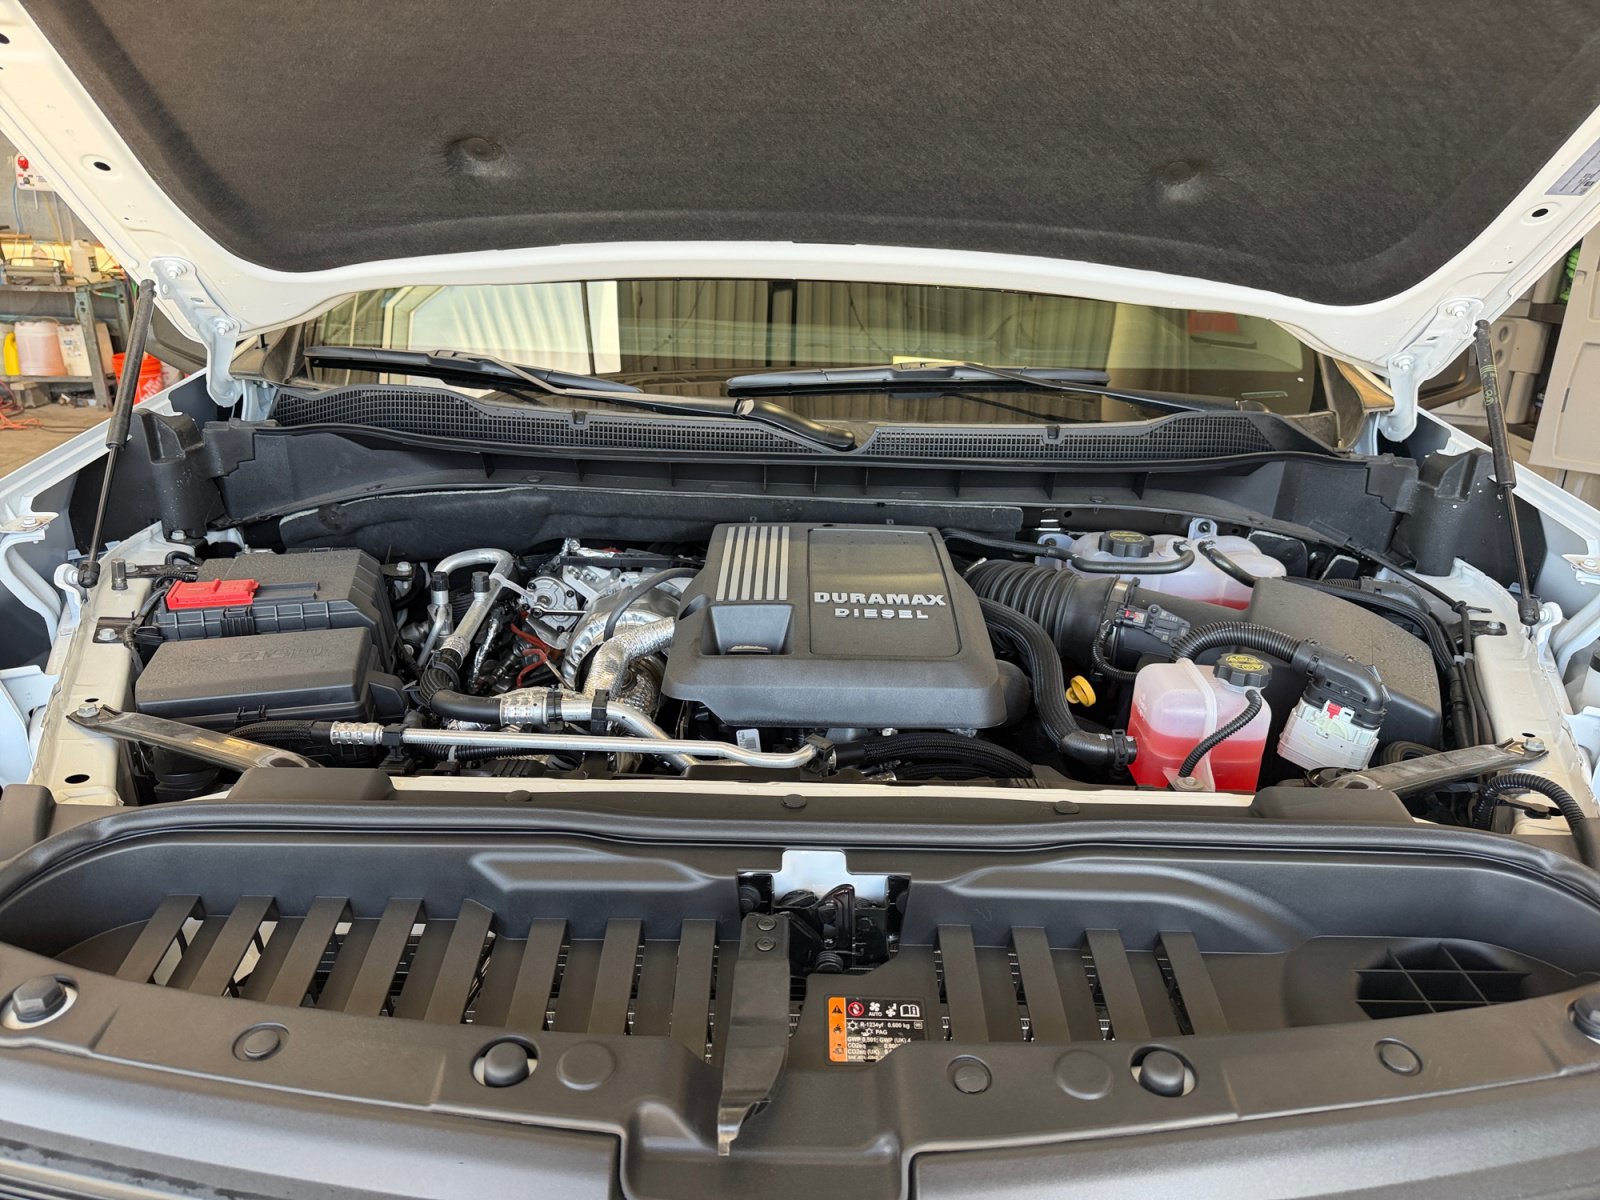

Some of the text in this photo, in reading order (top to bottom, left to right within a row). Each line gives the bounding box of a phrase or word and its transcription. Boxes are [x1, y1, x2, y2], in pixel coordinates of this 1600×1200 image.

[814, 592, 946, 606] DURAMAX
[834, 608, 929, 619] DIESEL
[860, 1021, 884, 1029] R-1234yf
